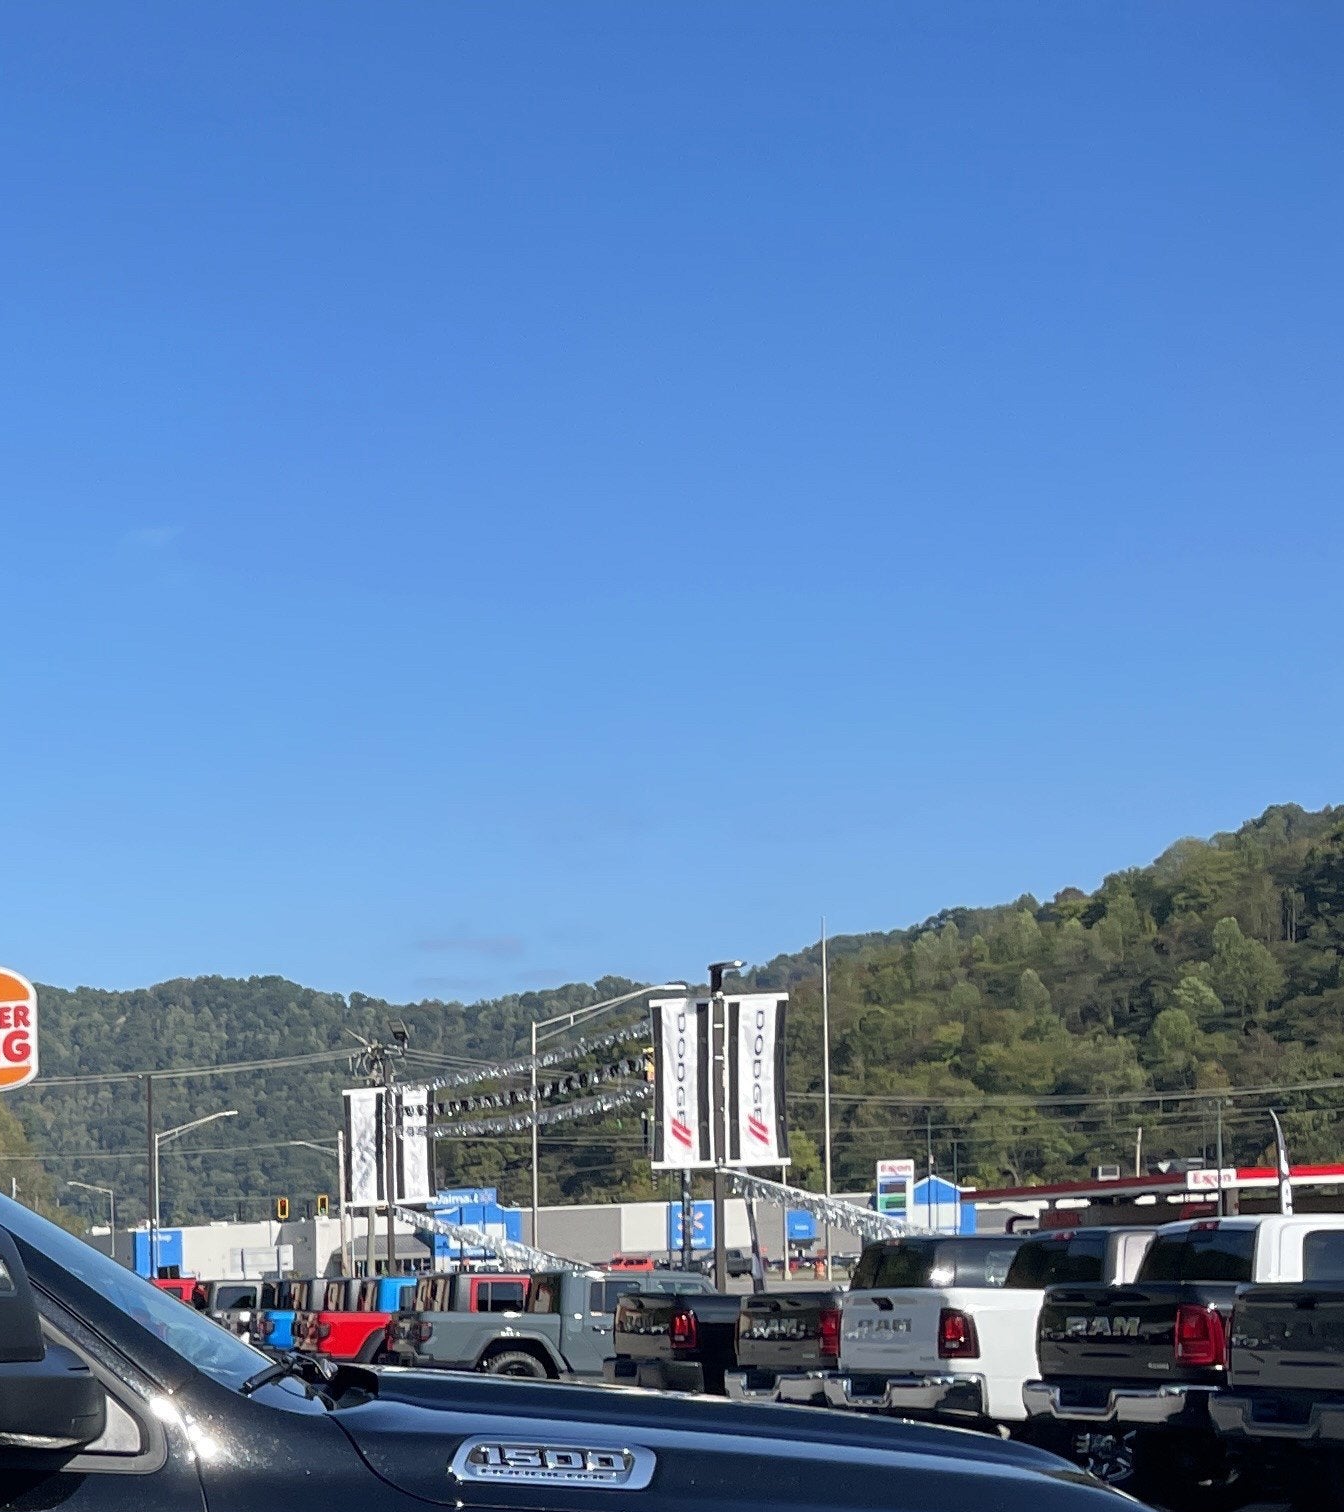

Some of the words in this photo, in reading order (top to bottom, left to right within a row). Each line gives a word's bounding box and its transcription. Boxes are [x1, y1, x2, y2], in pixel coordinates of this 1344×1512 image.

[677, 1012, 687, 1129] DODGE
[754, 1010, 766, 1125] DODGE
[1065, 1316, 1141, 1337] RAM
[483, 1447, 626, 1471] 1500
